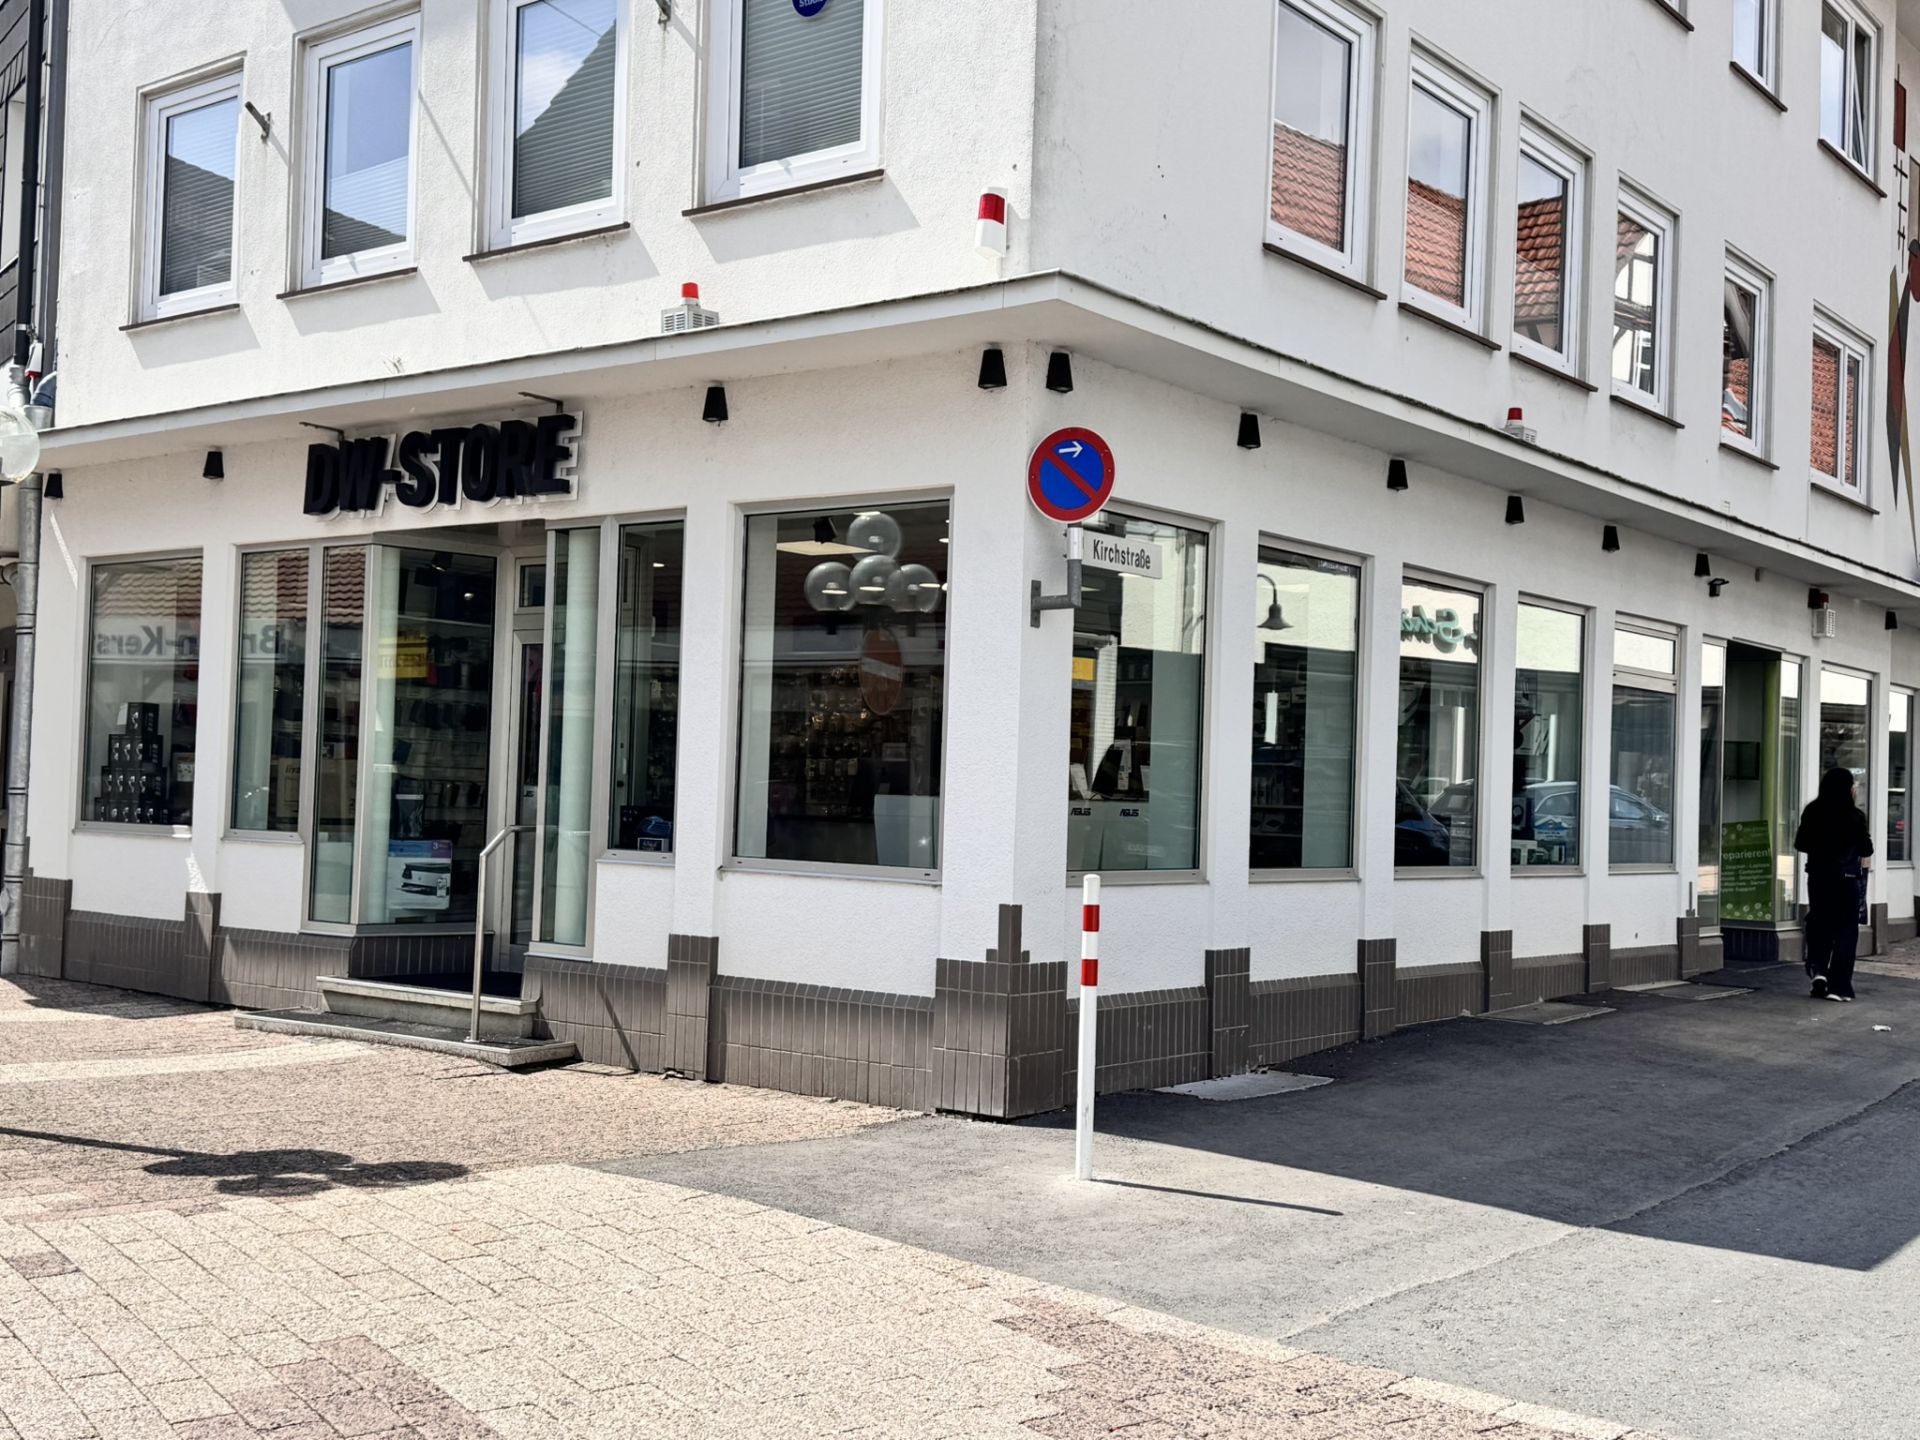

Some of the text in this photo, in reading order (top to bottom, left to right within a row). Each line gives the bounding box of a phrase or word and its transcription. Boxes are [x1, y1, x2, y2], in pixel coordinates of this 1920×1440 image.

[303, 411, 583, 519] DW-STORE
[1093, 539, 1151, 570] Kirchstraße
[1071, 807, 1091, 816] ASUS
[1120, 808, 1139, 817] ASUS
